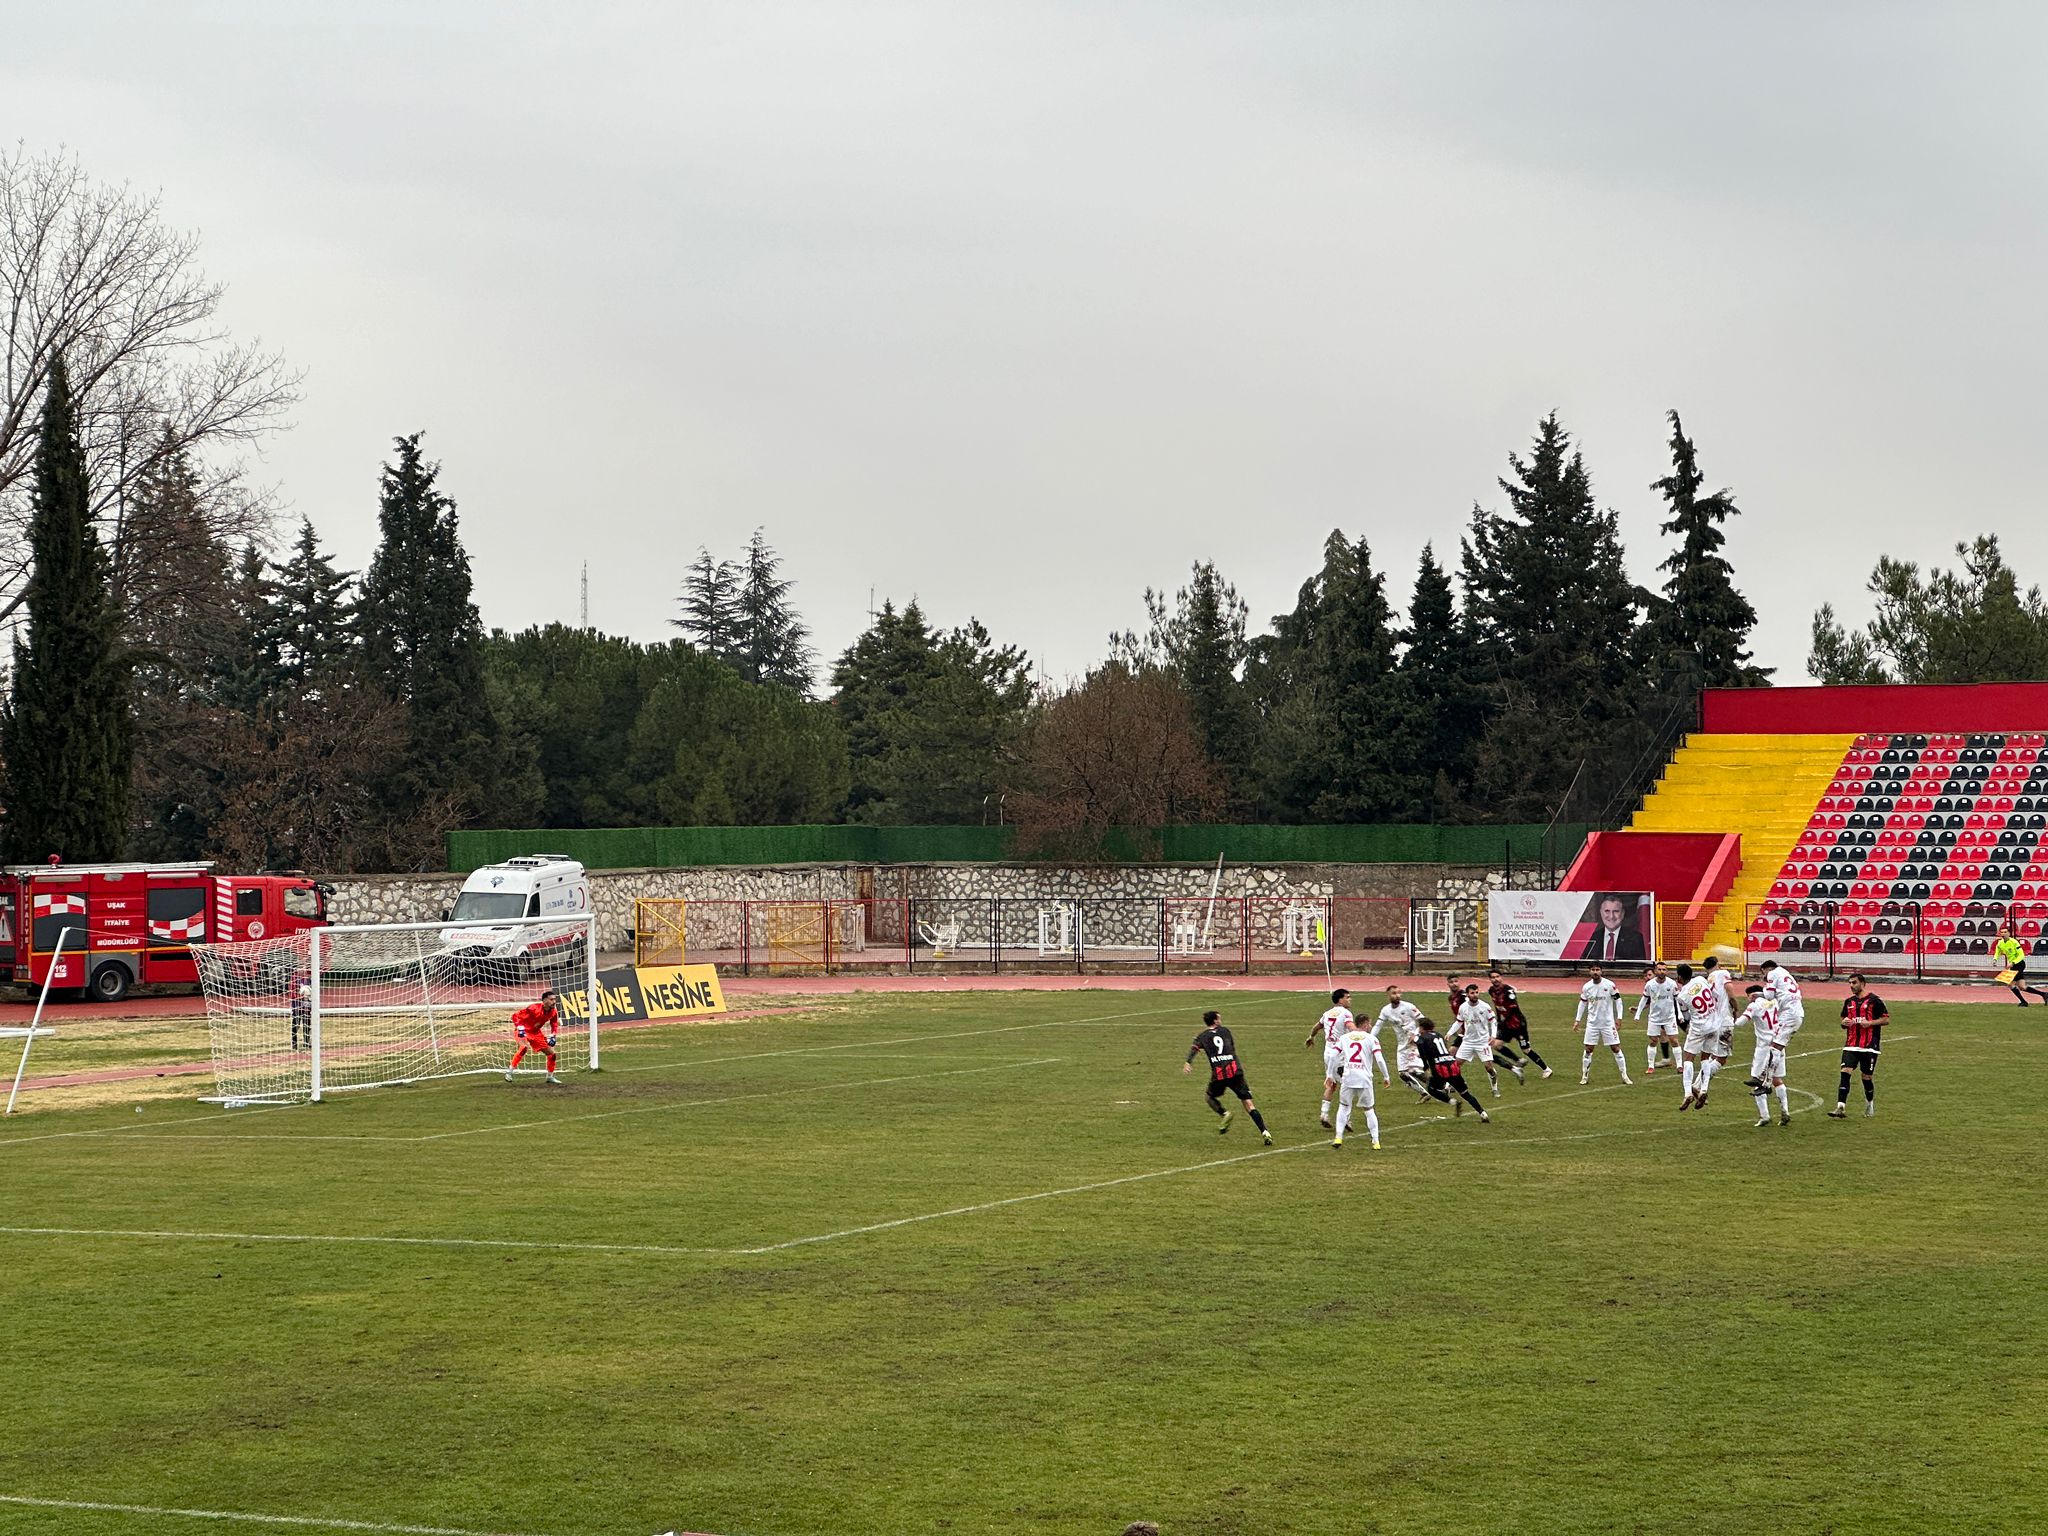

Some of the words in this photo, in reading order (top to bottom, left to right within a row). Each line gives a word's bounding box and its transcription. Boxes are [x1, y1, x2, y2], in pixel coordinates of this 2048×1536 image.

[106, 902, 126, 910] UŞAK
[104, 918, 130, 927] İTFAİYE
[1498, 922, 1514, 930] TÜM
[1514, 922, 1550, 930] ANTRENÖR
[1550, 923, 1560, 931] VE
[1500, 930, 1557, 938] SPORCULARIMIZA
[97, 938, 139, 946] MÜDÜRLÜĞÜ
[55, 964, 67, 973] 112
[1691, 988, 1715, 1014] 99
[1761, 1007, 1779, 1030] 14
[1327, 1018, 1338, 1037] 7
[1213, 1035, 1224, 1055] 9
[1433, 1037, 1449, 1055] 11
[1348, 1042, 1363, 1063] 2
